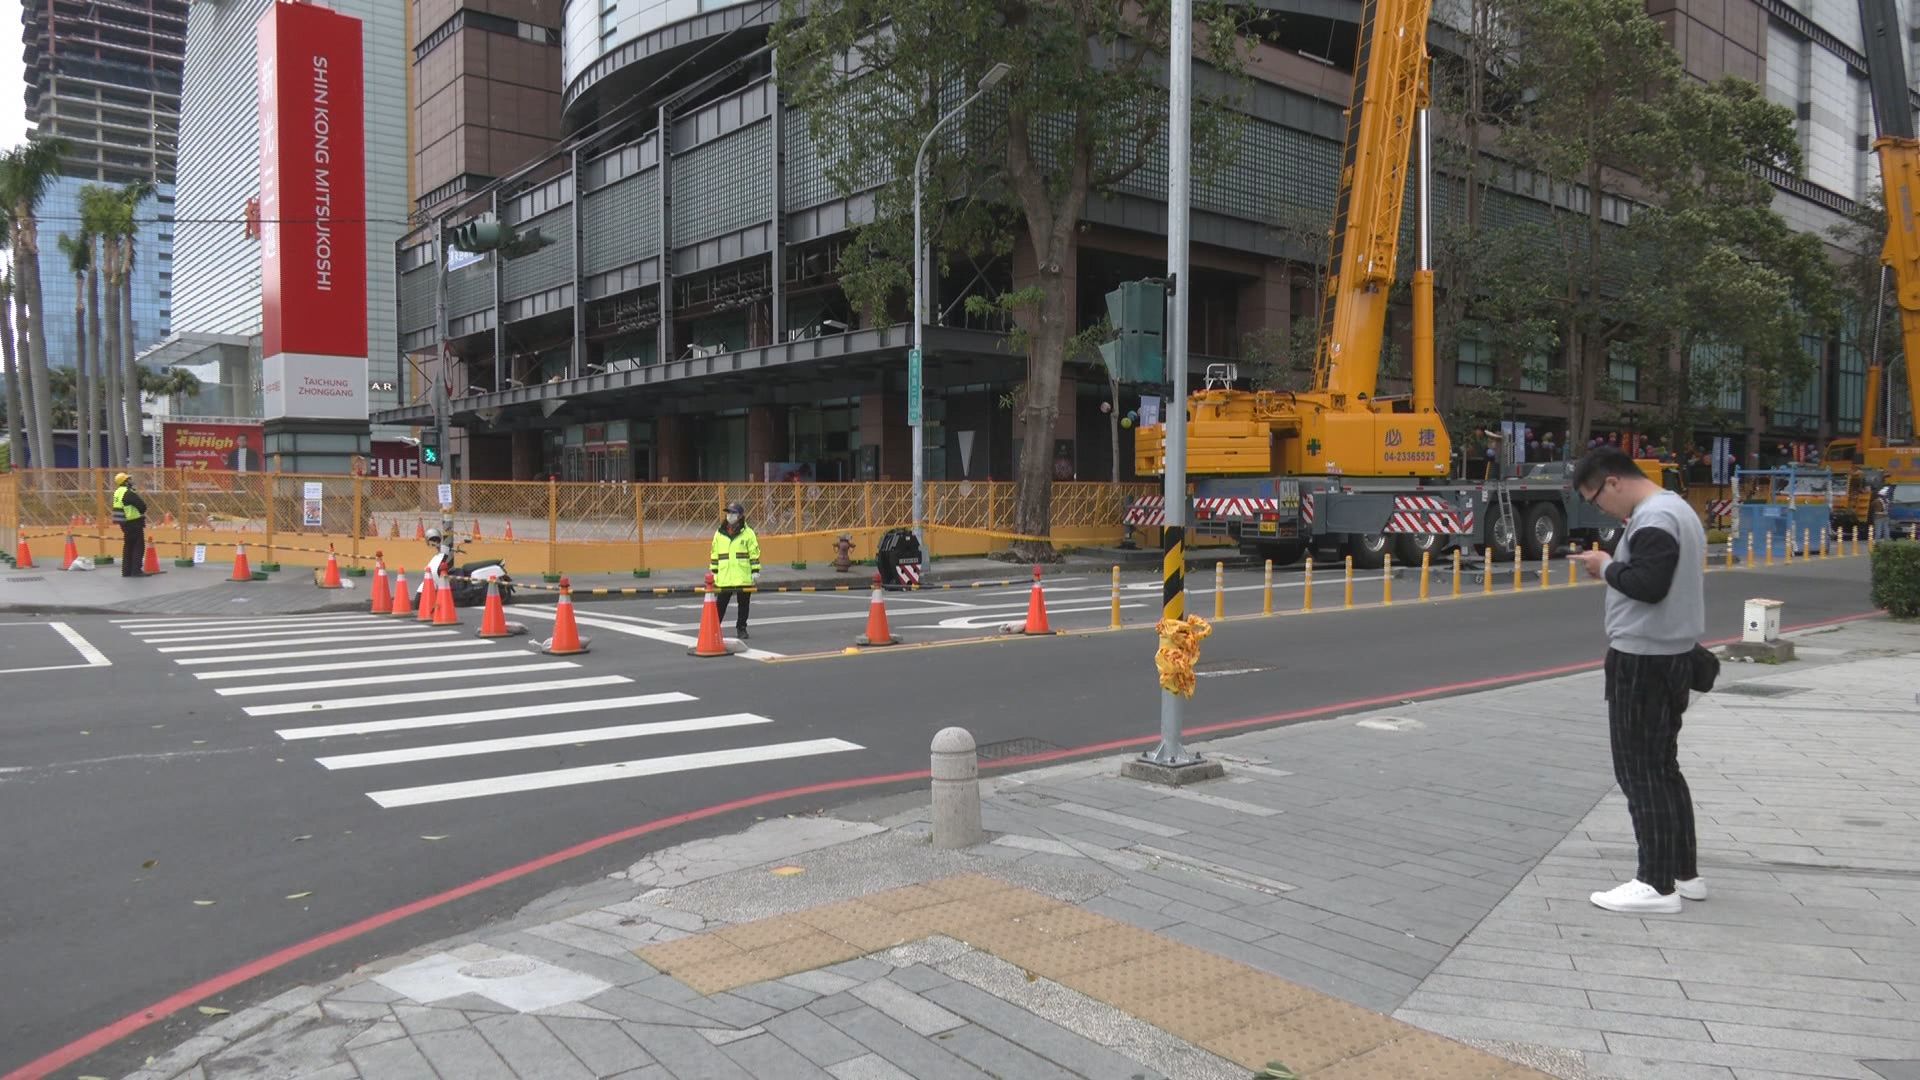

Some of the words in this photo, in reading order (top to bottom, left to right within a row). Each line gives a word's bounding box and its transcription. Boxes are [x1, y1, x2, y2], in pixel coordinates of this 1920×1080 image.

[313, 56, 328, 104] SHIN
[314, 107, 329, 164] KONG
[315, 169, 332, 291] MITSUKOSHI
[298, 386, 353, 397] ZHONGGANG
[303, 377, 348, 387] TAICHUNG
[1384, 451, 1435, 462] 04-23365525
